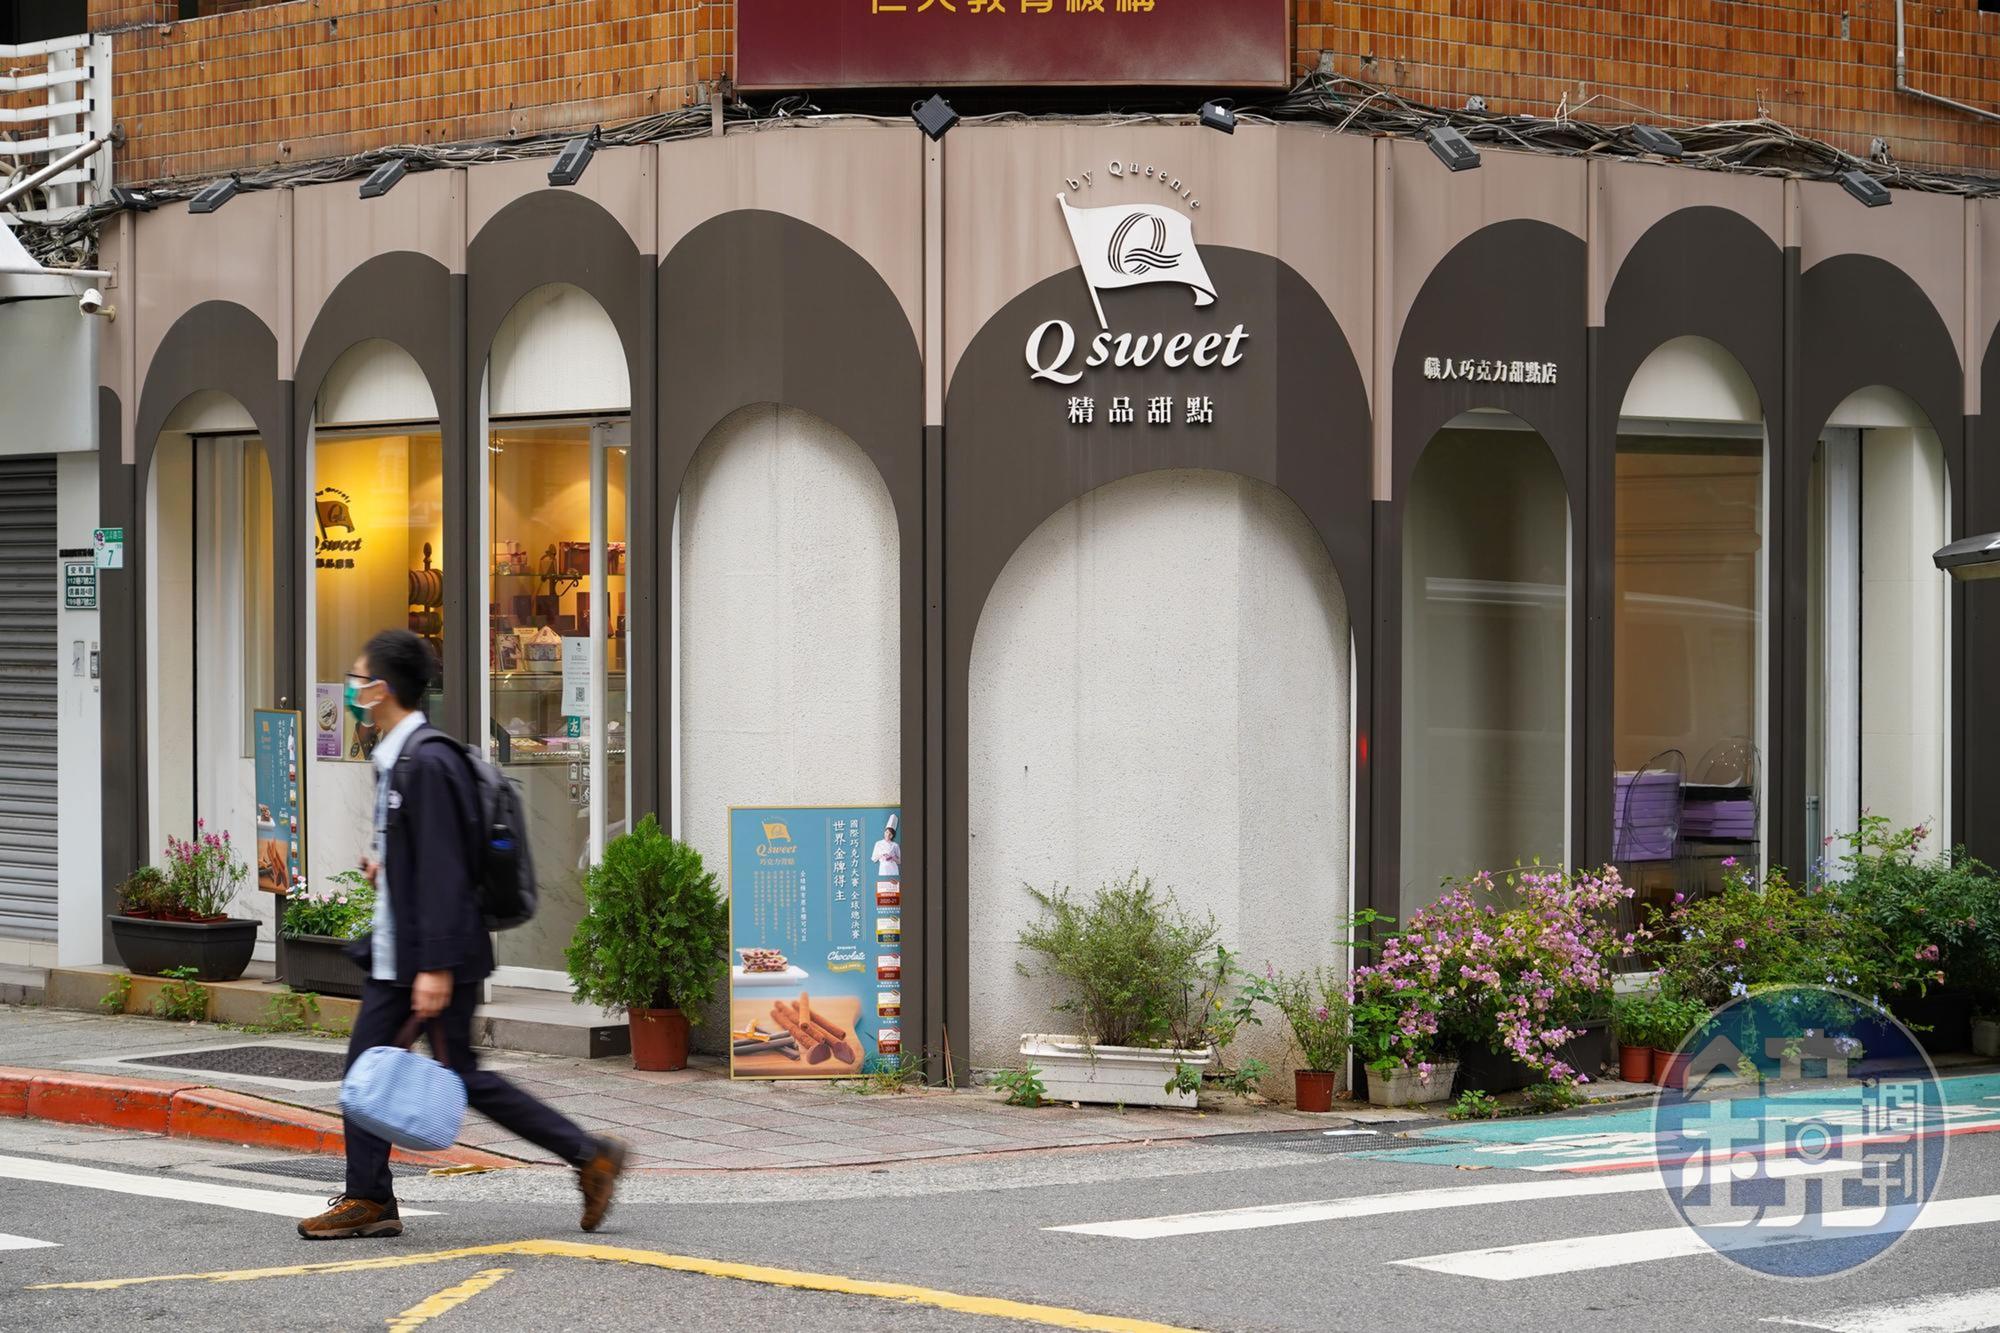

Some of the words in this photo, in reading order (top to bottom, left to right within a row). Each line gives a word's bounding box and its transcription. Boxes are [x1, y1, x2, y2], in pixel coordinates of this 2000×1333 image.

[1066, 170, 1093, 190] by
[1108, 160, 1201, 210] Queenie
[1067, 396, 1214, 424] 精品甜點
[108, 550, 114, 566] 7
[833, 820, 847, 901] 世界金牌得主
[827, 951, 866, 960] Chocolate
